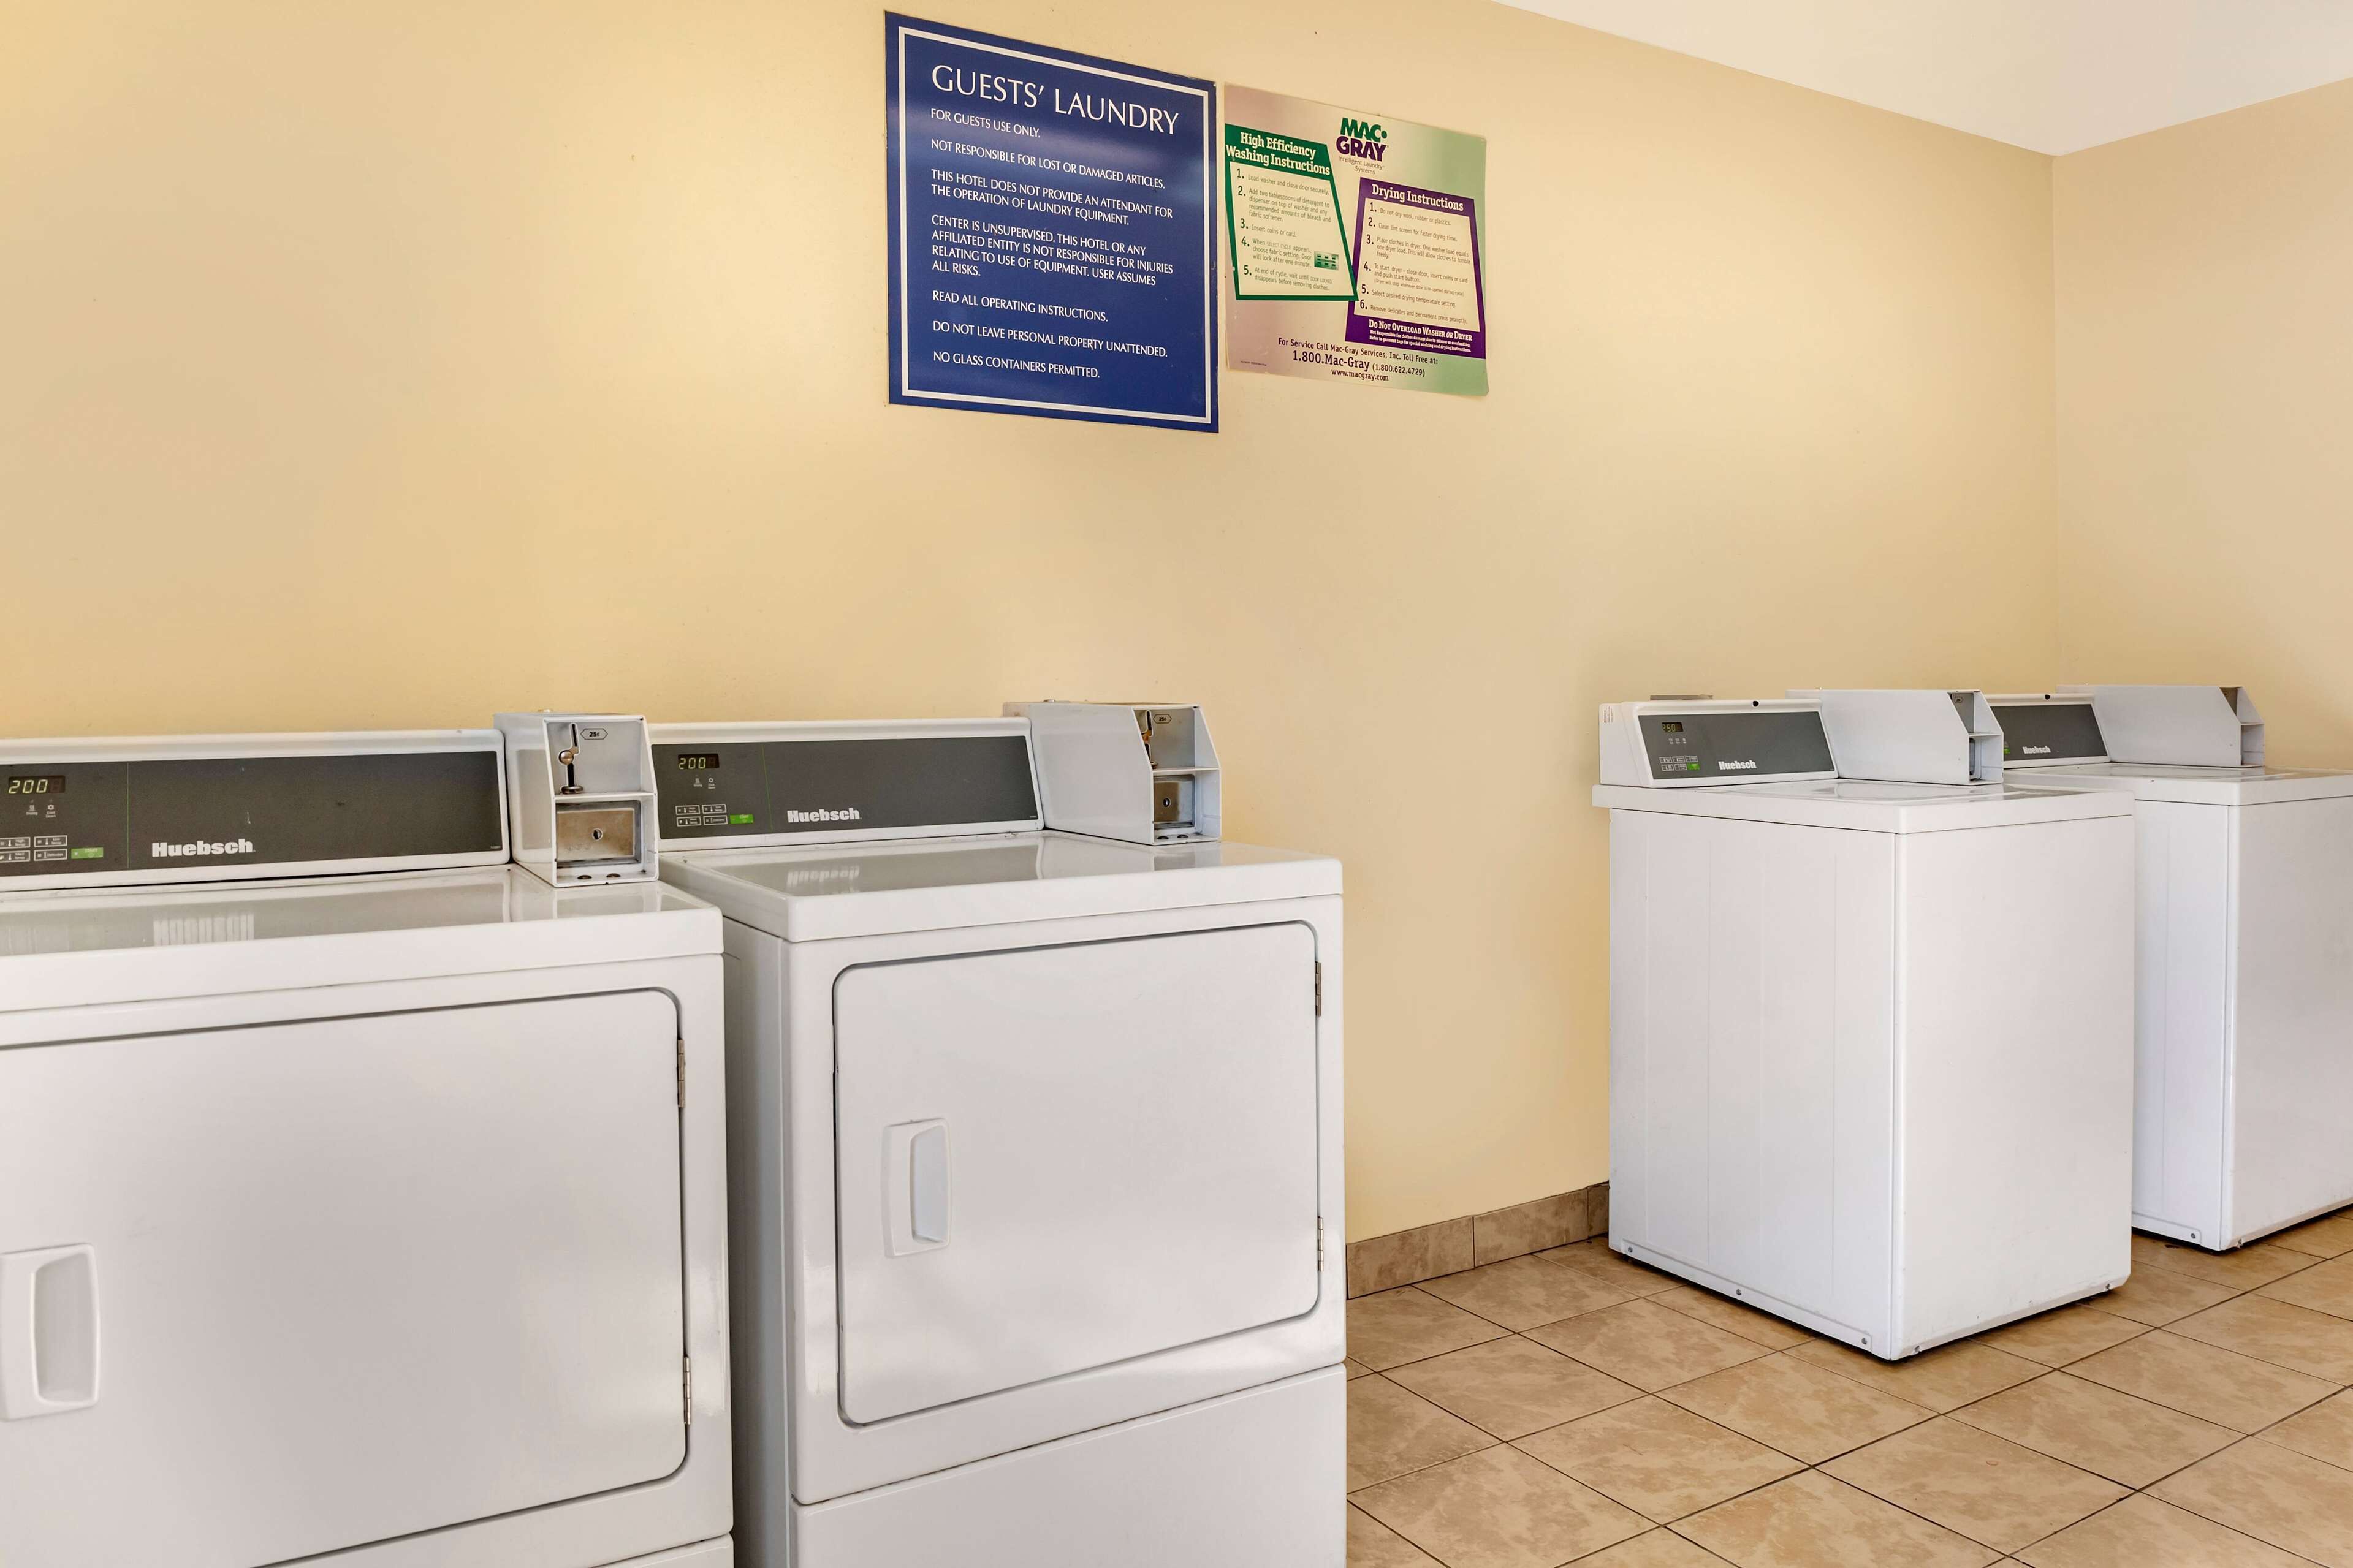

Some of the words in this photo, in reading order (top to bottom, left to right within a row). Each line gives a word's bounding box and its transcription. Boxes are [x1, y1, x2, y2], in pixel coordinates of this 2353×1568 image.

[1055, 88, 1179, 134] LAUNDRY
[930, 108, 951, 121] FOR
[953, 112, 990, 129] GUESTS
[993, 119, 1011, 133] USE
[1013, 123, 1040, 138] ONLY.
[1240, 131, 1265, 149] High
[1266, 137, 1316, 159] Efficiency
[1336, 135, 1386, 162] GRAY
[931, 138, 952, 151] NOT
[955, 142, 1015, 163] RESPONSIBLE
[1017, 153, 1036, 167] FOR
[1038, 157, 1061, 170] LOST
[1062, 162, 1077, 174] OR
[1079, 164, 1123, 181] DAMAGED
[1125, 173, 1165, 189] ARTICLES.
[1225, 144, 1269, 166] Washing
[1270, 153, 1330, 175] Instructions
[1337, 154, 1362, 167] Intelligent
[1363, 159, 1383, 171] Laundry
[1354, 165, 1375, 175] Systems
[1236, 167, 1244, 179] 1.
[1247, 173, 1260, 182] Load
[1285, 181, 1298, 189] close
[1309, 186, 1329, 196] securely.
[1237, 185, 1246, 197] 2.
[930, 168, 953, 182] THIS
[956, 173, 988, 188] HOTEL
[990, 178, 1017, 192] DOES
[1019, 183, 1040, 196] NOT
[1043, 187, 1082, 203] PROVIDE
[1084, 195, 1098, 206] AN
[1100, 197, 1153, 214] ATTENDANT
[1155, 206, 1173, 218] FOR
[1371, 183, 1405, 203] Drying
[1407, 190, 1464, 211] Instructions
[931, 183, 951, 197] THE
[952, 187, 1009, 206] OPERATION
[1011, 197, 1025, 208] OF
[1027, 199, 1073, 216] LAUNDRY
[1074, 207, 1129, 225] EQUIPMENT.
[1369, 202, 1377, 212] 1.
[1239, 218, 1249, 229] 3.
[1251, 223, 1266, 232] Insert
[1367, 216, 1375, 227] 2.
[931, 214, 969, 230] CENTER
[971, 220, 980, 231] IS
[983, 222, 1055, 243] UNSUPERVISED.
[1056, 233, 1078, 246] THIS
[1079, 237, 1109, 251] HOTEL
[1111, 241, 1125, 253] OR
[1127, 244, 1146, 256] ANY
[1241, 235, 1250, 247] 4.
[1366, 233, 1374, 245] 3.
[931, 230, 985, 246] AFFILIATED
[987, 237, 1020, 252] ENTITY
[1022, 243, 1031, 254] IS
[1033, 244, 1054, 257] NOT
[1056, 248, 1114, 266] RESPONSIBLE
[1116, 256, 1135, 268] FOR
[1136, 259, 1173, 274] INJURIES
[932, 244, 979, 261] RELATING
[981, 251, 995, 263] TO
[997, 254, 1016, 266] USE
[1017, 257, 1031, 268] OF
[1033, 259, 1089, 276] EQUIPMENT.
[1092, 267, 1114, 280] USER
[1116, 271, 1156, 286] ASSUMES
[932, 260, 950, 272] ALL
[952, 262, 981, 276] RISKS.
[1243, 264, 1252, 276] 5.
[1363, 260, 1371, 271] 4.
[1361, 283, 1369, 294] 5.
[932, 290, 959, 303] READ
[961, 294, 979, 306] ALL
[981, 296, 1035, 312] OPERATING
[1038, 303, 1108, 322] INSTRUCTIONS.
[1359, 298, 1367, 309] 6.
[933, 320, 950, 332] DO
[952, 322, 975, 335] NOT
[977, 325, 1005, 339] LEAVE
[1007, 329, 1056, 344] PERSONAL
[1058, 335, 1104, 350] PROPERTY
[1106, 341, 1168, 357] UNATTENDED.
[1278, 337, 1289, 346] For
[1290, 338, 1314, 349] Service
[1315, 342, 1328, 351] Call
[1330, 344, 1359, 356] Mac-Gray
[1360, 347, 1387, 358] Services,
[1389, 351, 1401, 360] Inc.
[1402, 353, 1413, 362] Toll
[1415, 354, 1428, 363] Free
[933, 350, 950, 362] NO
[952, 352, 983, 366] GLASS
[985, 356, 1046, 373] CONTAINERS
[1048, 363, 1100, 378] PERMITTED.
[1293, 350, 1370, 372] 1.800.Mac-Gray
[1372, 362, 1425, 378] (1.800.622.4729)
[1331, 369, 1389, 381] www.macgray.com
[678, 757, 706, 770] 200
[1718, 760, 1757, 770] Huebsch
[8, 779, 48, 794] 200
[787, 808, 859, 823] Huebsch
[151, 838, 253, 857] Huebsch
